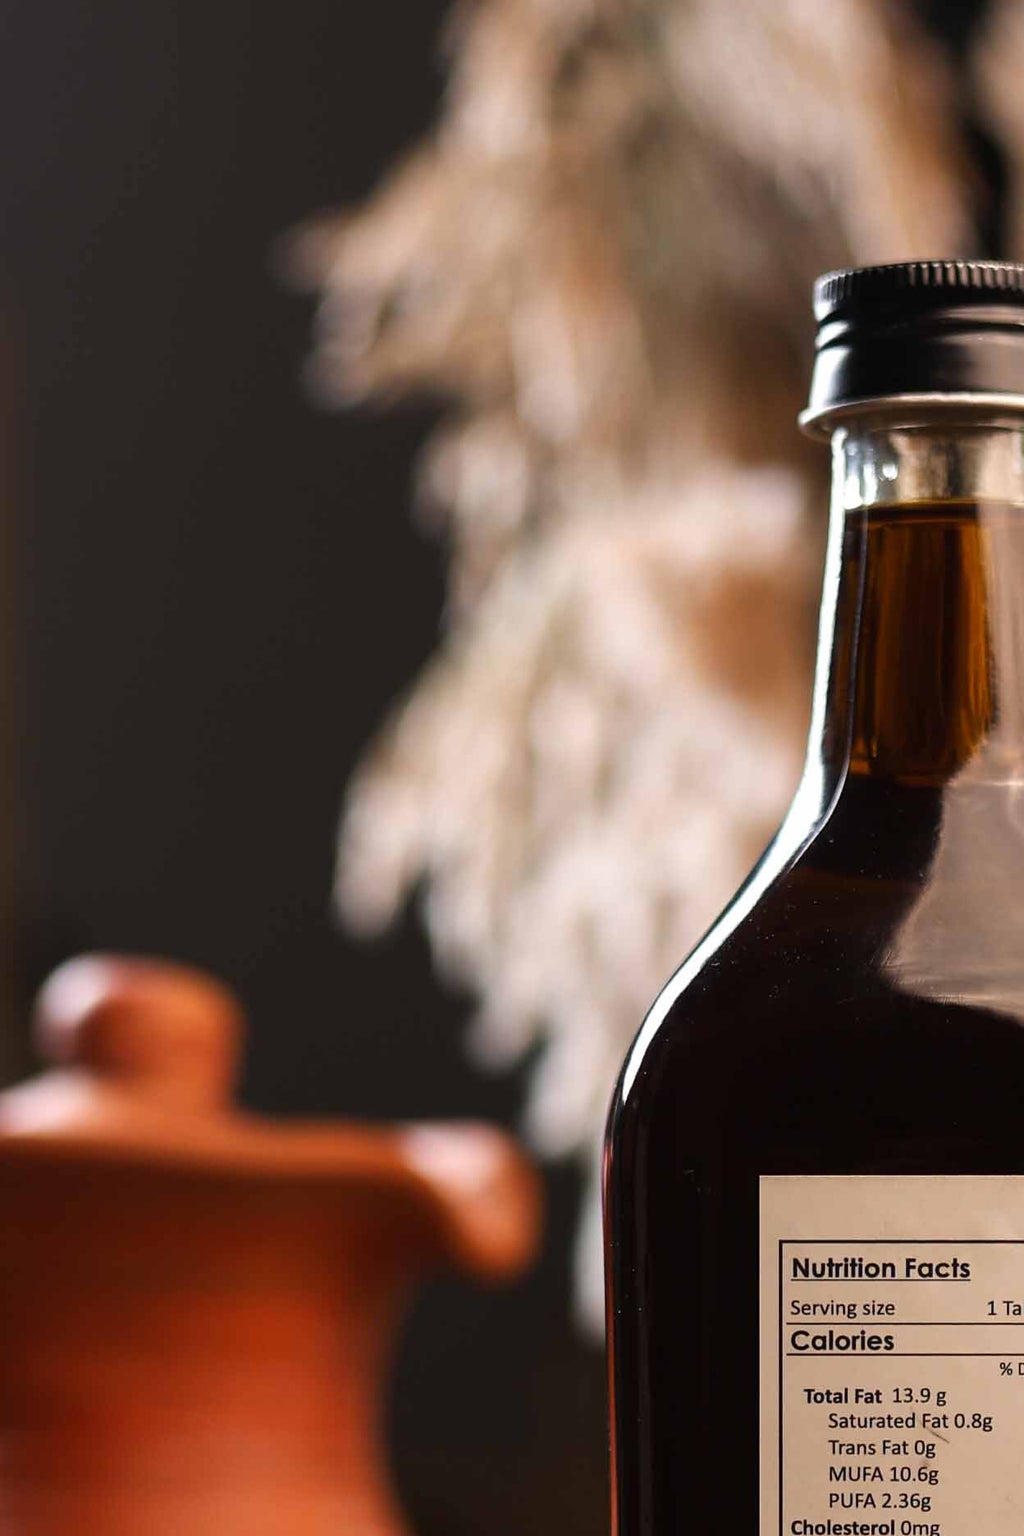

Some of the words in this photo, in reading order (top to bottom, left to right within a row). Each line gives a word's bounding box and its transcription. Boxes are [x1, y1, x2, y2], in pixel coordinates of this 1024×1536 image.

[792, 1256, 896, 1279] Nutrition
[905, 1257, 971, 1279] Facts
[790, 1299, 858, 1320] Serving
[862, 1299, 896, 1316] size
[986, 1299, 998, 1317] 1
[790, 1329, 895, 1352] Calories
[999, 1361, 1014, 1377] %
[802, 1386, 849, 1405] Total
[854, 1388, 883, 1405] Fat
[892, 1387, 931, 1404] 13.9
[935, 1391, 947, 1408] g
[827, 1411, 916, 1429] Saturated
[921, 1412, 950, 1429] Fat
[953, 1412, 993, 1433] 0.8g
[827, 1439, 877, 1456] Trans
[882, 1439, 910, 1456] Fat
[913, 1439, 936, 1460] 0g
[828, 1465, 885, 1483] MUFA
[889, 1463, 940, 1486] 10.6g
[828, 1492, 877, 1509] PUFA
[881, 1492, 932, 1513] 2.36g
[790, 1518, 896, 1536] Cholesterol
